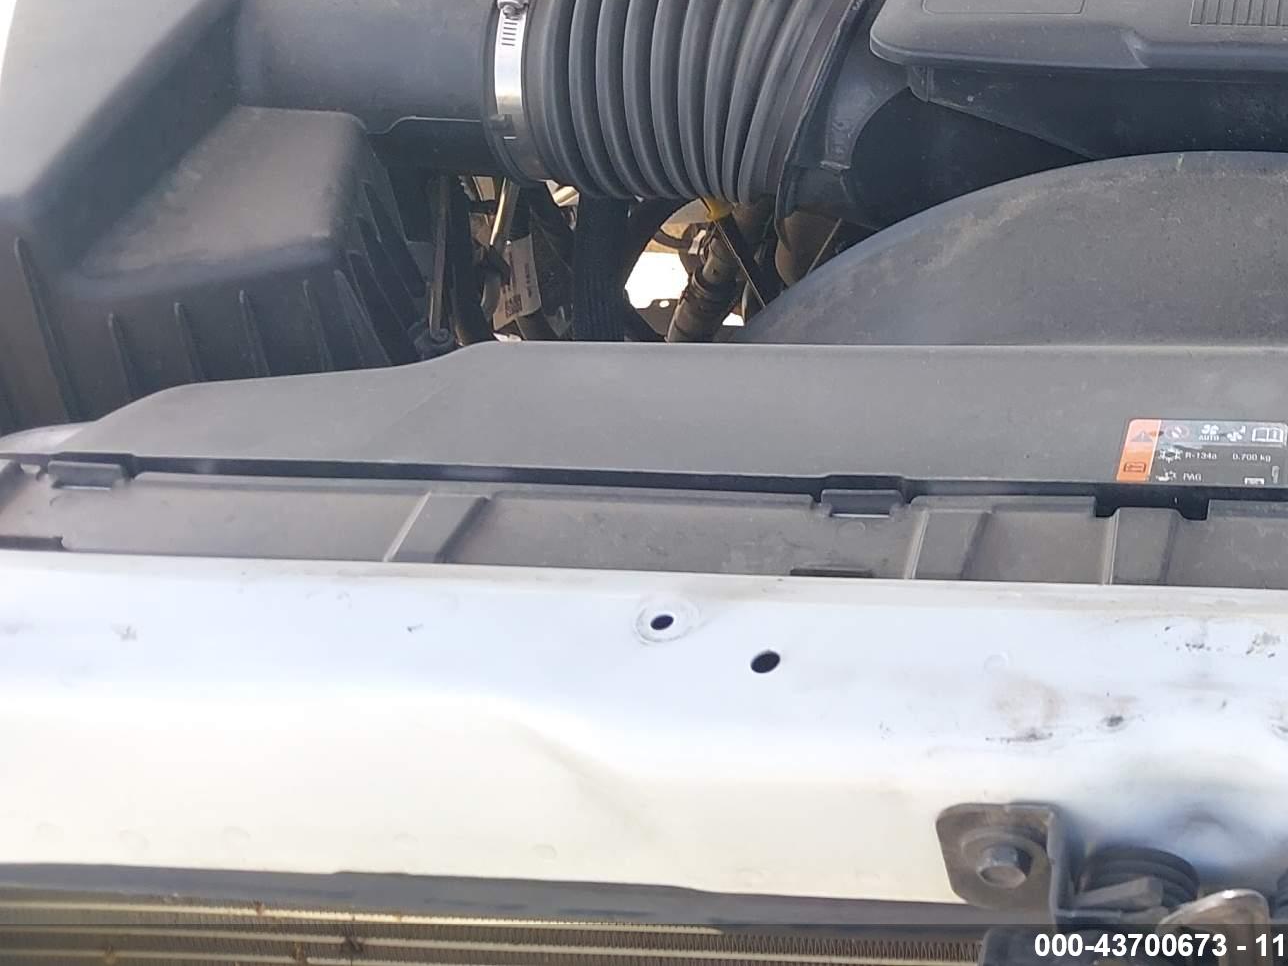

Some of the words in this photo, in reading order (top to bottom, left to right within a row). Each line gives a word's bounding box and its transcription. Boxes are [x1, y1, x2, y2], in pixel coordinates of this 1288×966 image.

[1184, 451, 1218, 460] R-134a
[1260, 452, 1272, 463] kg
[1183, 472, 1202, 482] PAG
